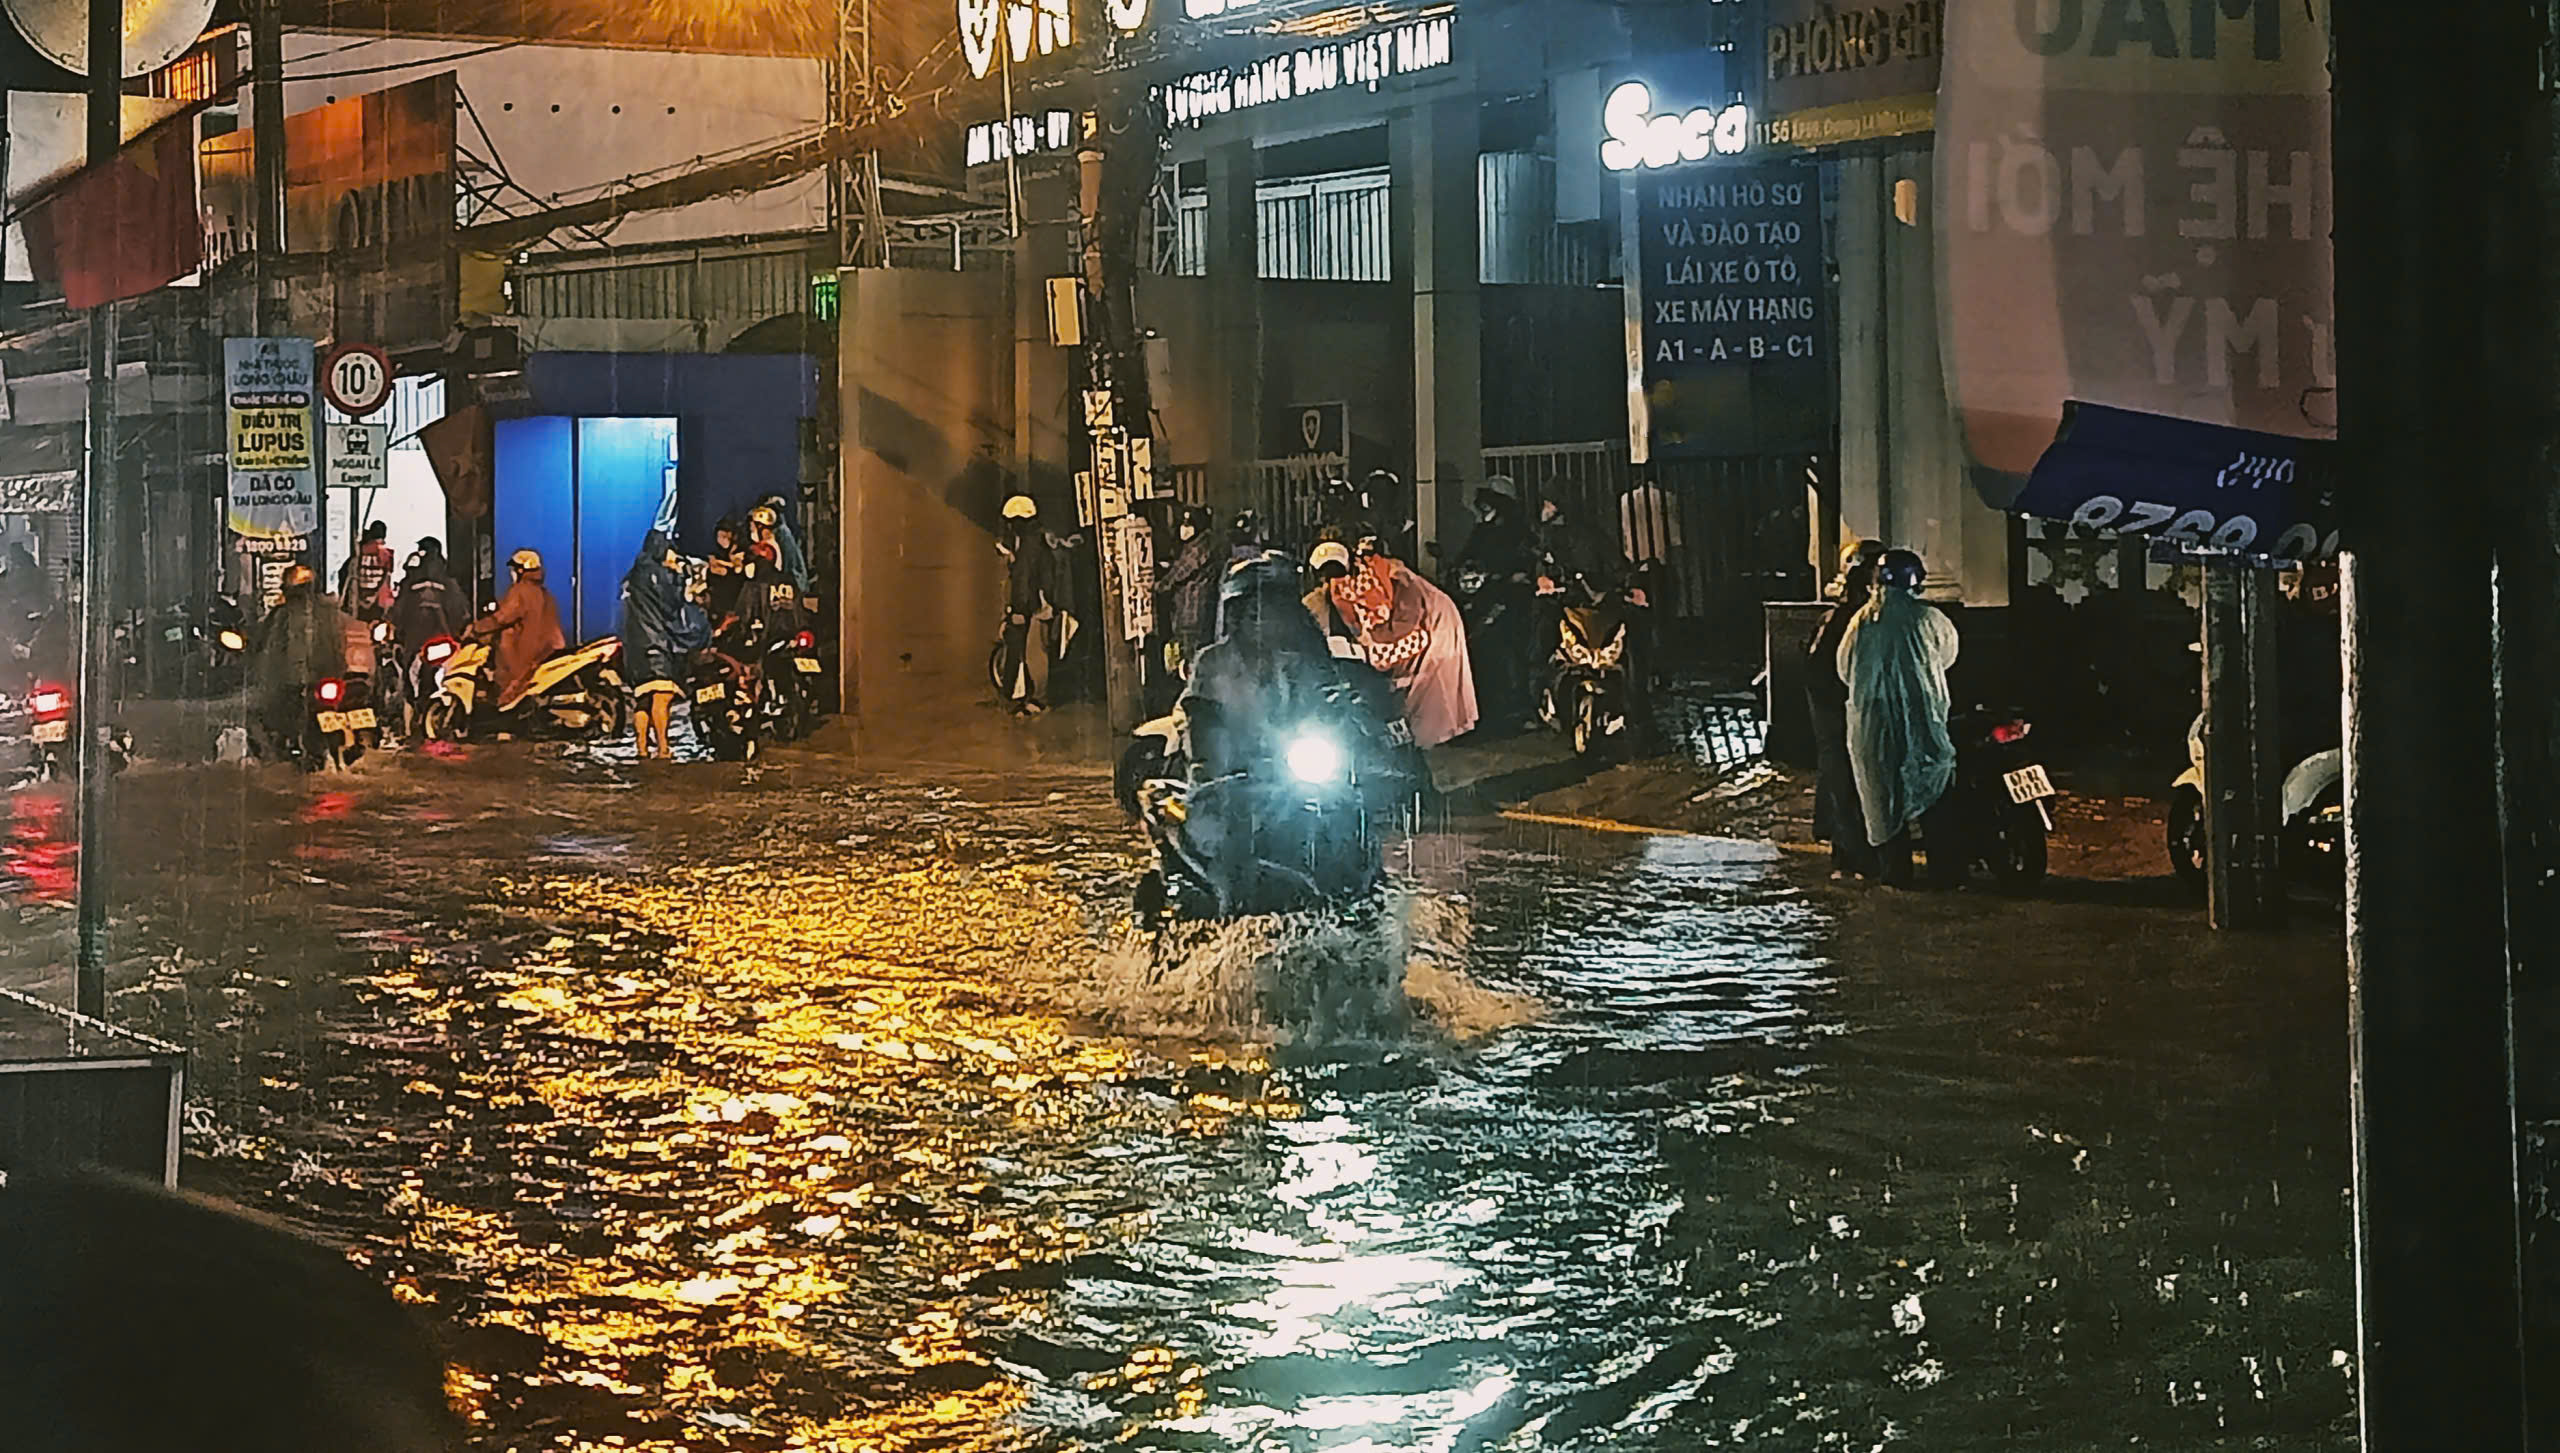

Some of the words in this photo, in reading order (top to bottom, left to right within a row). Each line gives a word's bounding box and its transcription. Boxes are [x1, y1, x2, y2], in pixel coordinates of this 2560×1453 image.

[1343, 32, 1392, 92] VIỆT
[1663, 218, 1696, 247] VÀ
[1701, 219, 1749, 245] ĐÀO
[1755, 221, 1801, 250] TẠO
[1666, 255, 1703, 285] LÁI
[1710, 260, 1739, 284] XE
[1655, 300, 1686, 323] XE
[1691, 293, 1741, 322] MÁY
[1748, 297, 1814, 325] HẠNG
[1656, 339, 1684, 362] A1
[1710, 338, 1727, 361] A
[1749, 337, 1764, 358] B
[1787, 335, 1813, 357] C1
[238, 433, 304, 452] LUPUS
